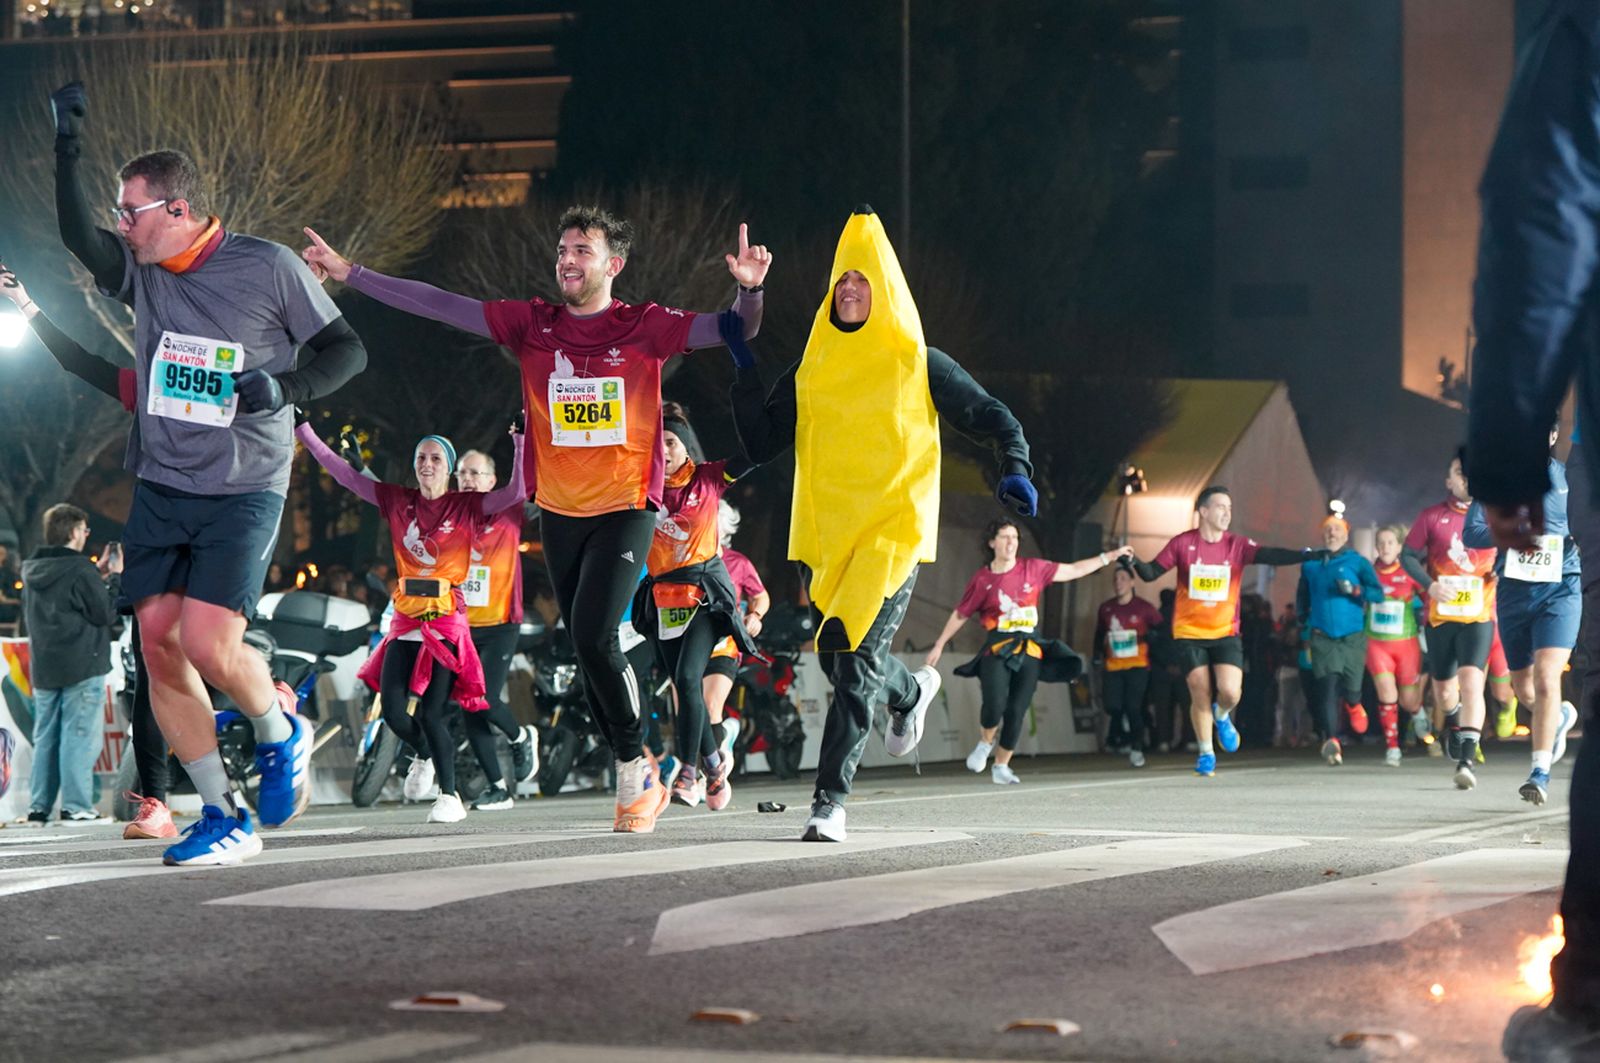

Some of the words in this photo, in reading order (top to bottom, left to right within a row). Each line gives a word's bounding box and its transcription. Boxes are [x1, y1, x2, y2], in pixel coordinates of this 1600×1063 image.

[172, 343, 197, 354] NOCHE
[197, 348, 208, 356] DE
[163, 351, 178, 362] SAN
[165, 363, 223, 396] 9595
[564, 385, 586, 393] NOCHE
[587, 385, 596, 393] DE
[557, 394, 571, 402] SAN
[564, 403, 612, 423] 5264
[662, 522, 676, 534] 43
[411, 544, 425, 557] 43
[1518, 550, 1552, 566] 3228
